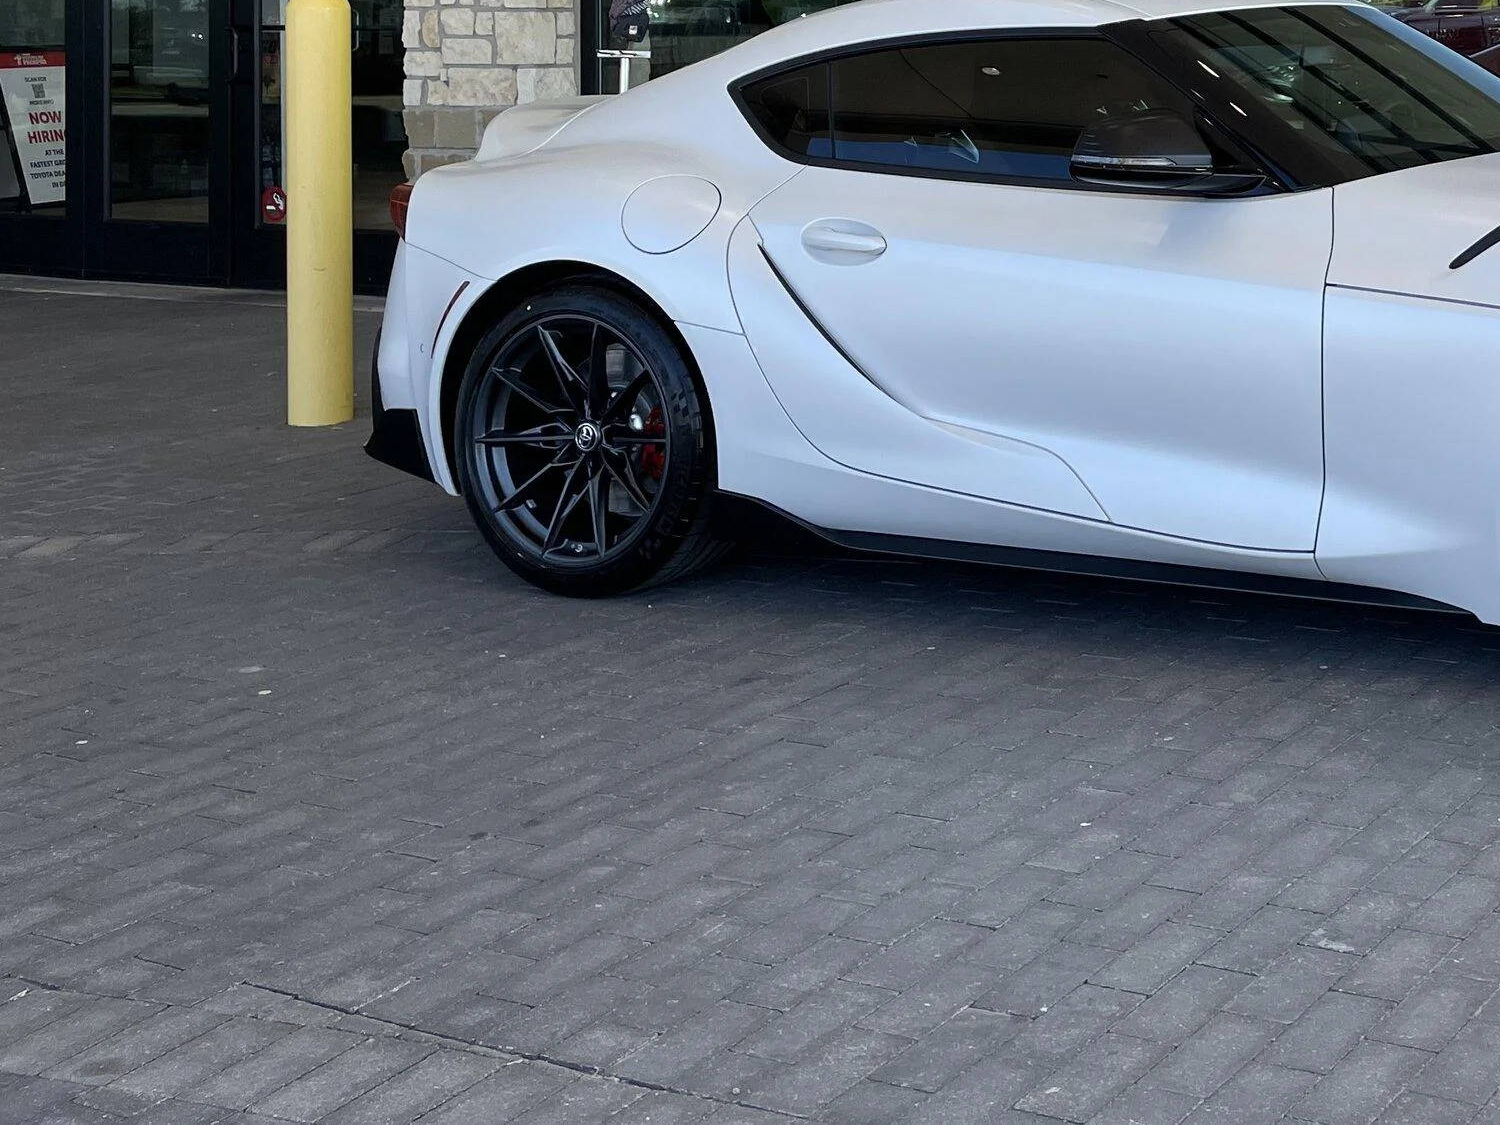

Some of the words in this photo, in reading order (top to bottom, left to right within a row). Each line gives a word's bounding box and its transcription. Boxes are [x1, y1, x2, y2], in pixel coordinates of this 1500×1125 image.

[28, 110, 62, 125] NOW
[30, 160, 54, 168] FASTEST
[30, 171, 54, 180] TOYOTA
